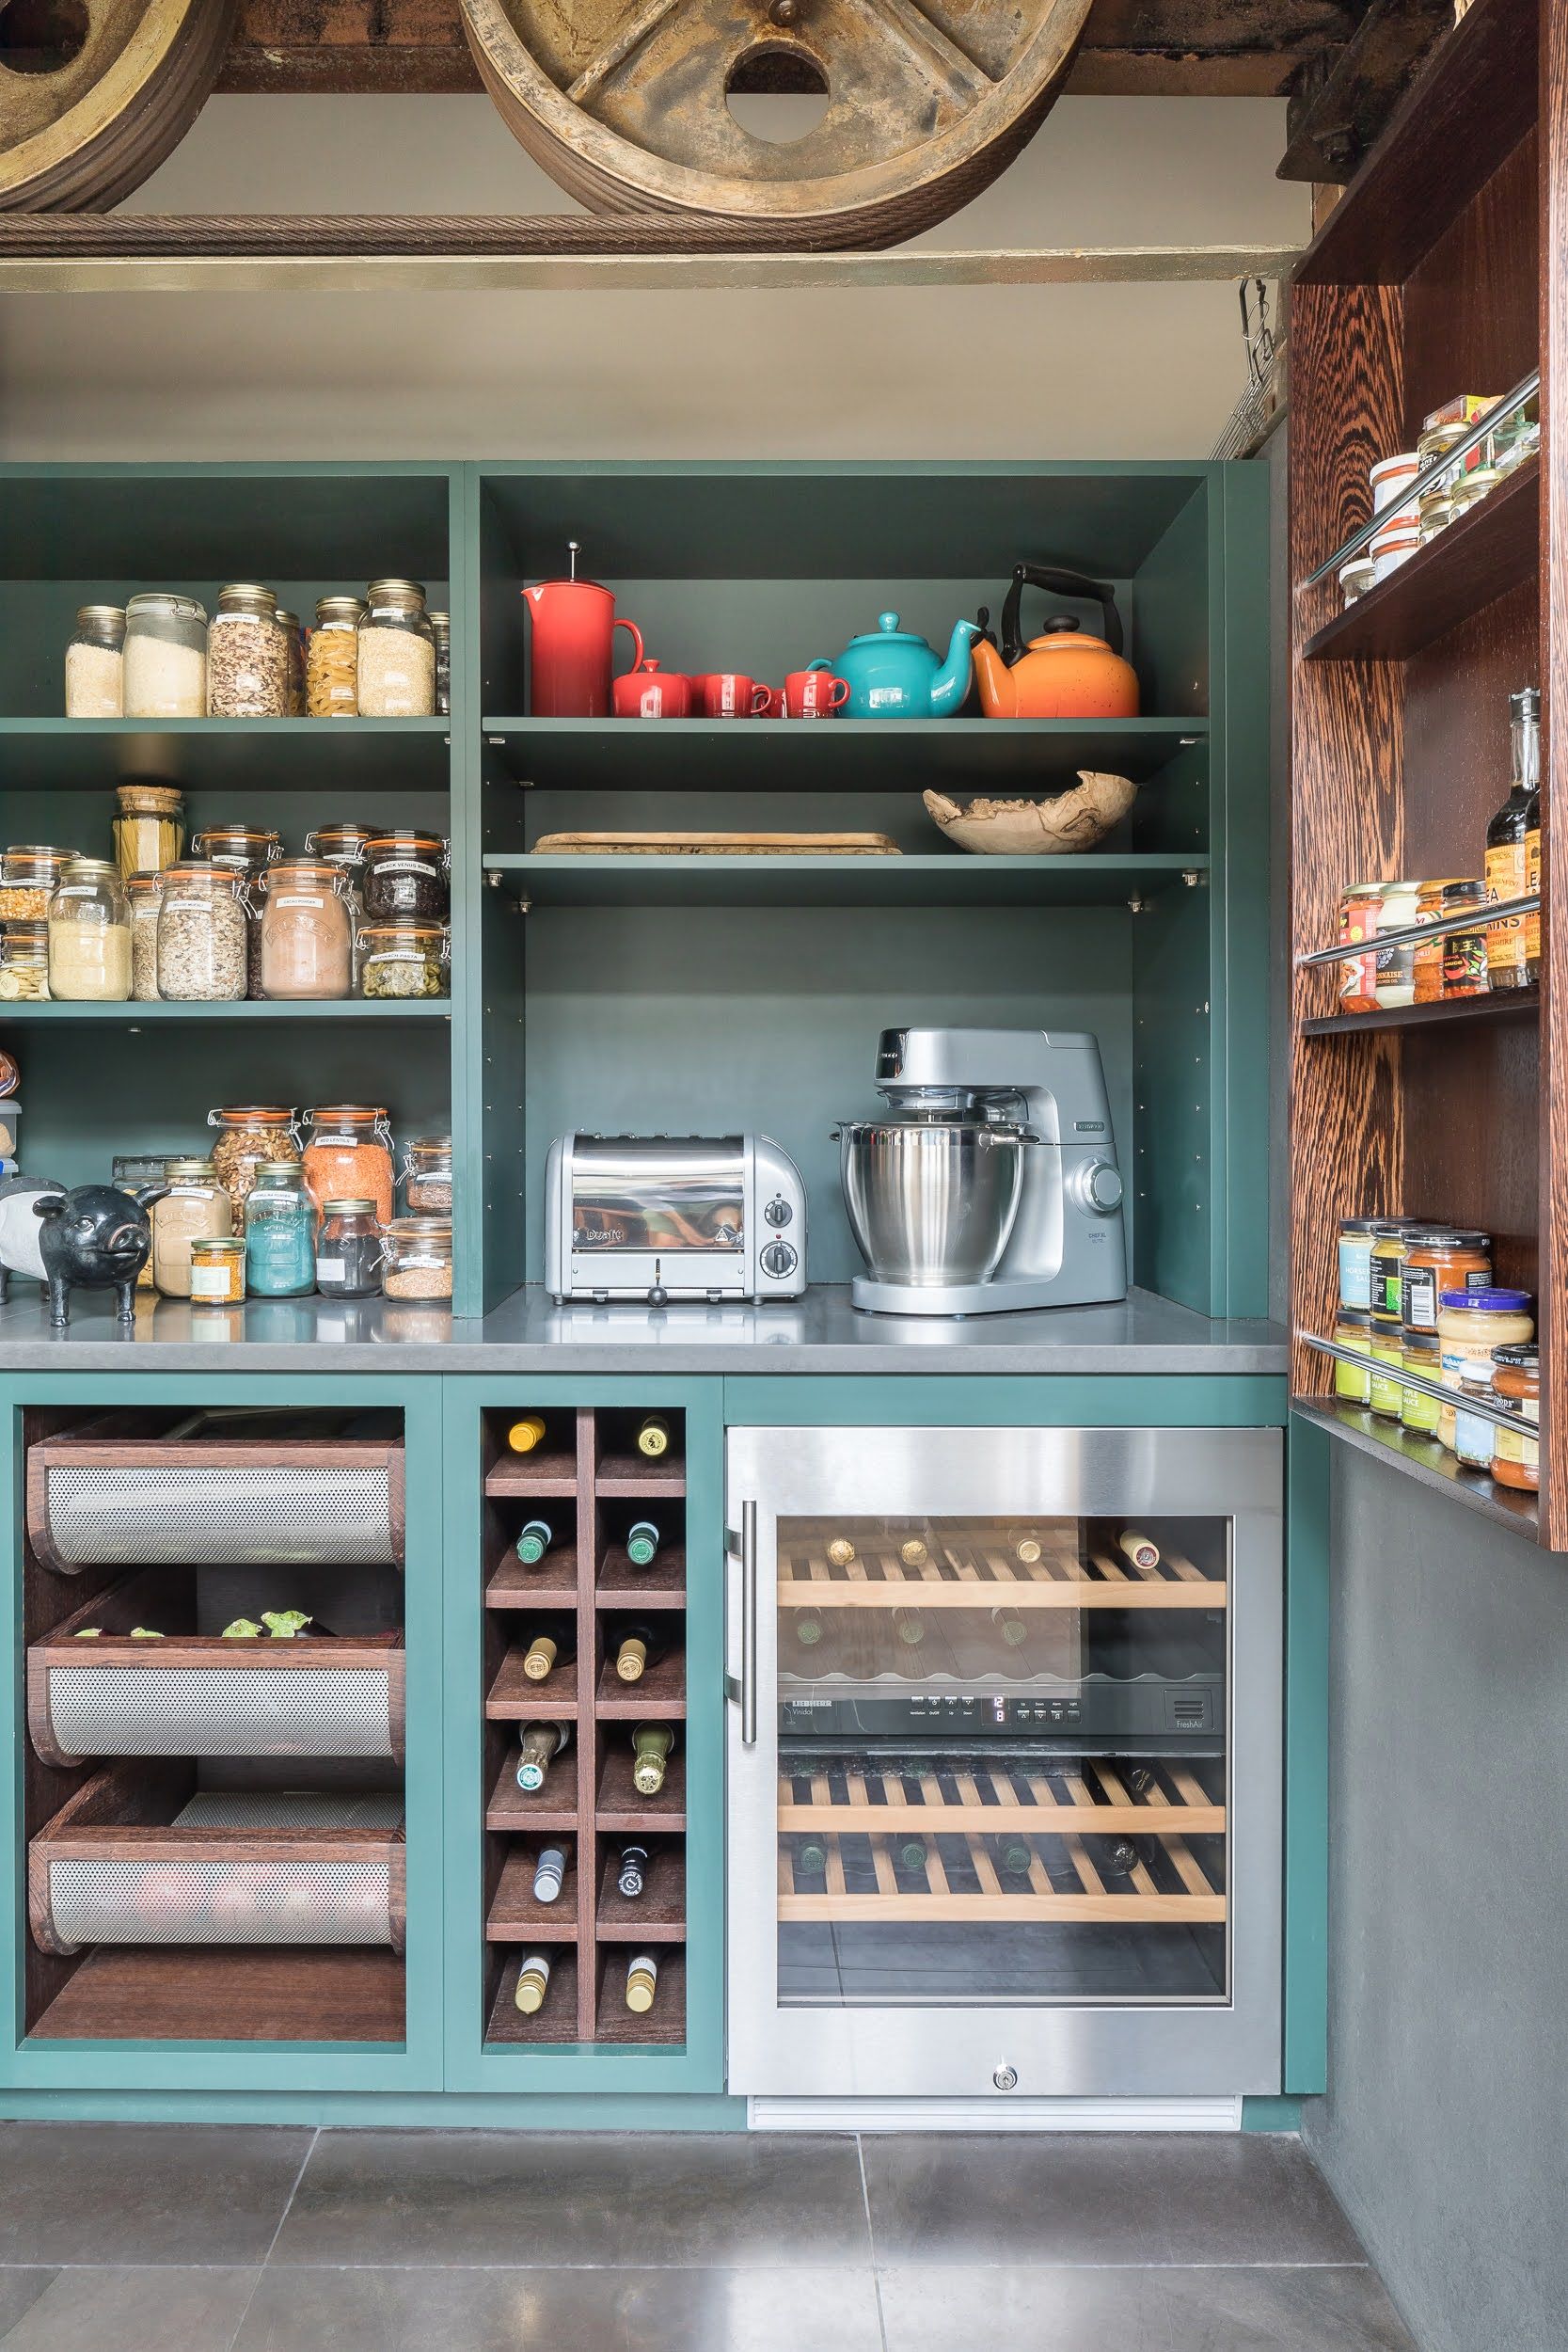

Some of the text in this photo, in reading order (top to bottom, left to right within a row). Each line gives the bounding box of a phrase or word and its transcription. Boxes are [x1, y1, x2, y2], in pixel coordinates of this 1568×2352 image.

[379, 862, 397, 870] BLACK
[418, 863, 430, 872] RICE
[586, 1228, 624, 1242] Dualit
[993, 1695, 1005, 1708] 12
[996, 1710, 1006, 1723] 8
[1177, 1720, 1203, 1728] FreshAir
